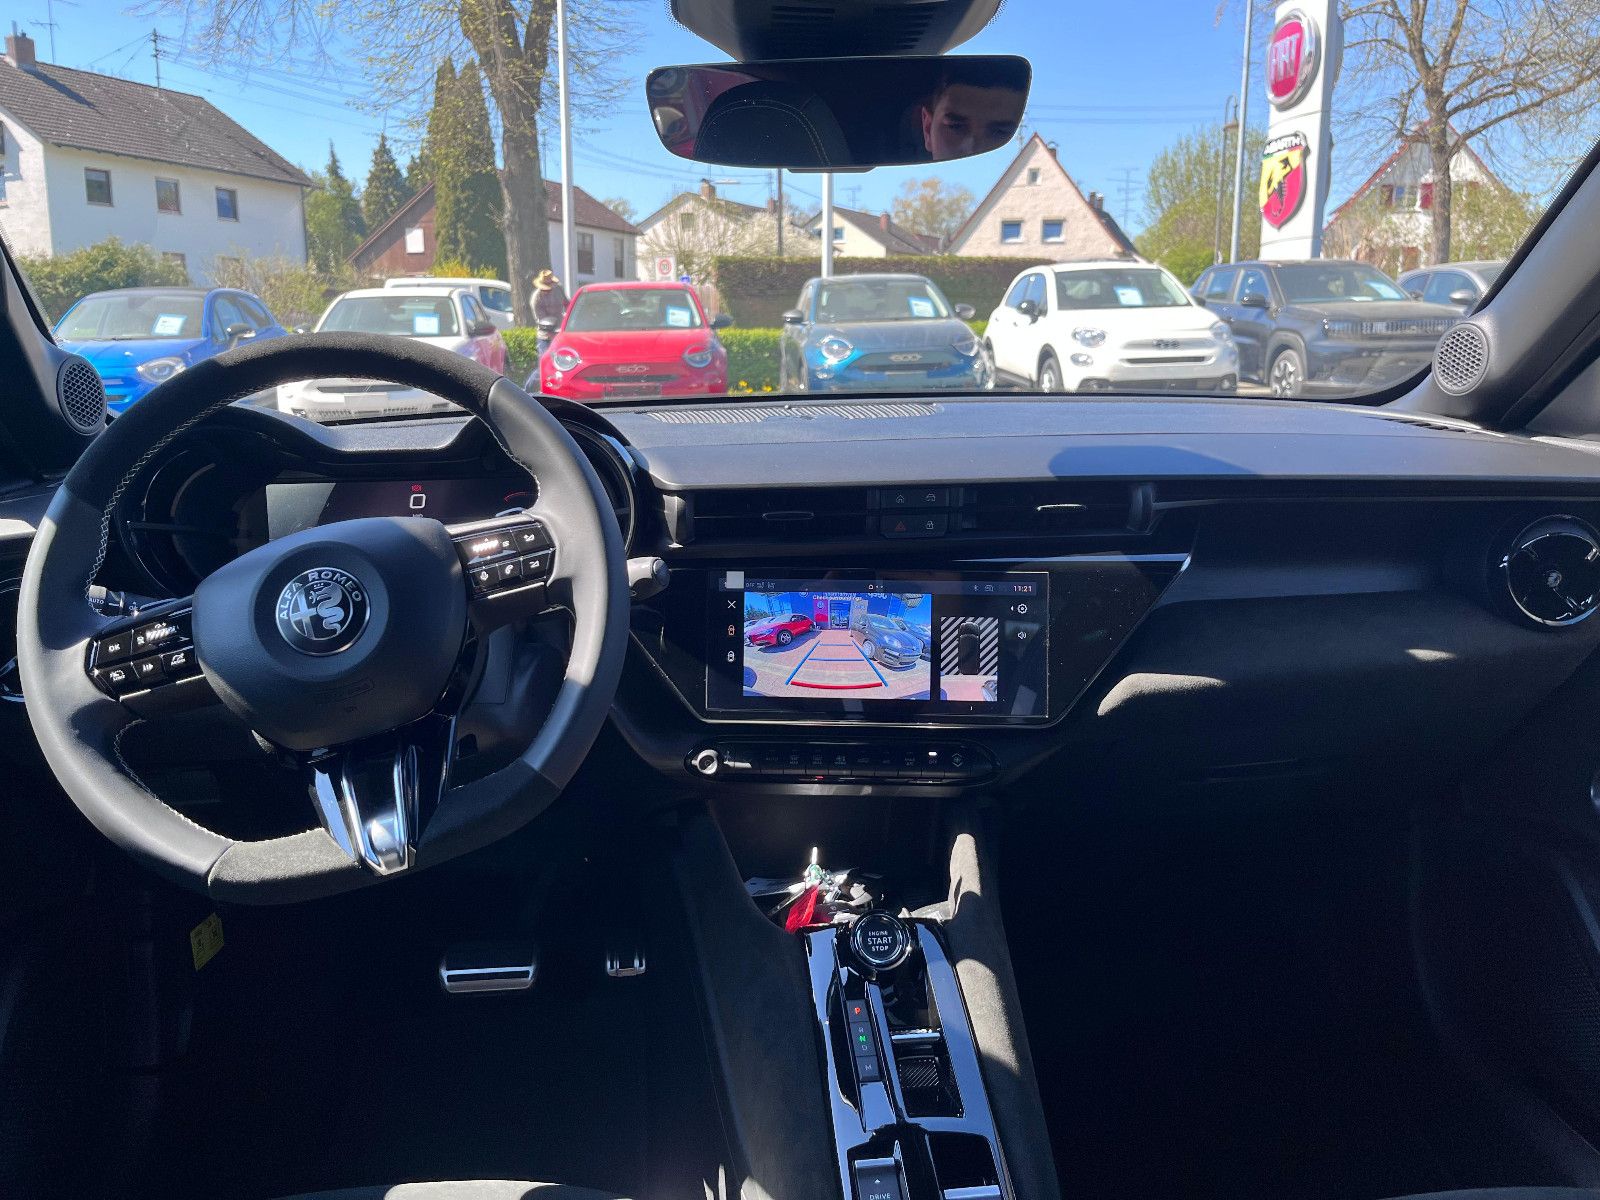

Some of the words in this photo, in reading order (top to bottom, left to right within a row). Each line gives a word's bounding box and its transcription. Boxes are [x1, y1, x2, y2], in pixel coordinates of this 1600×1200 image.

[1270, 33, 1300, 81] FIAT
[279, 582, 303, 620] ALFA
[307, 570, 362, 601] ROMEO
[108, 643, 121, 652] OK
[867, 936, 893, 945] START
[854, 1007, 861, 1015] P
